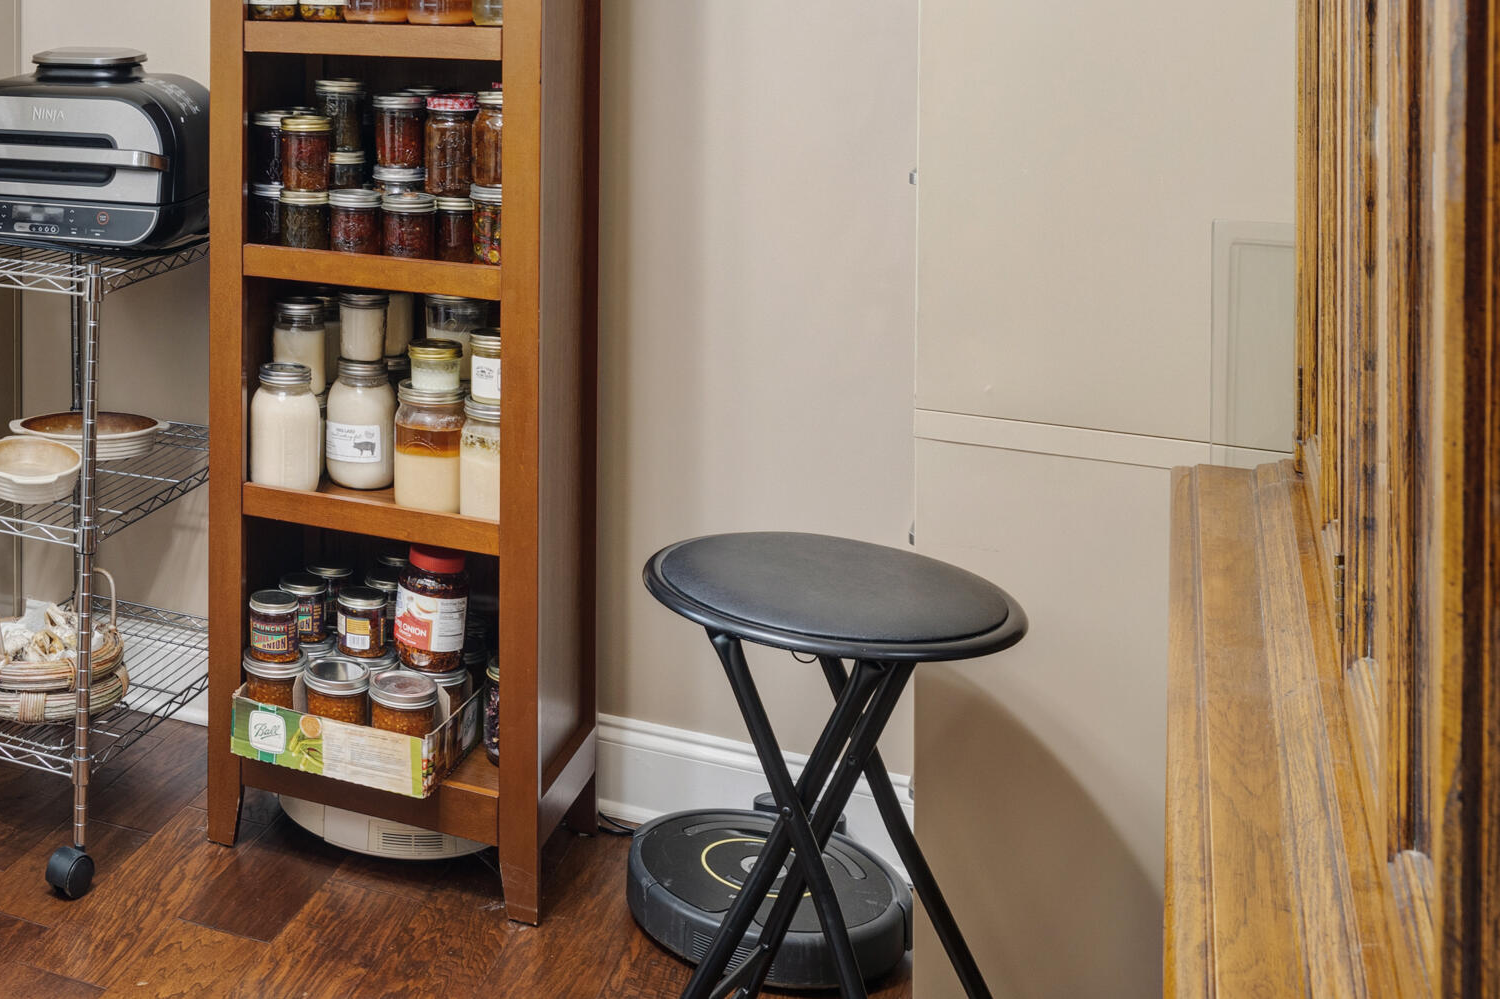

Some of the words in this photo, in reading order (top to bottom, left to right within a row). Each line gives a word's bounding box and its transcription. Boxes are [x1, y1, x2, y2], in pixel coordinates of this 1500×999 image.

[32, 105, 67, 122] NINJA
[253, 623, 285, 632] CRUNCHY
[402, 623, 427, 638] ONION
[254, 722, 281, 738] Ball
